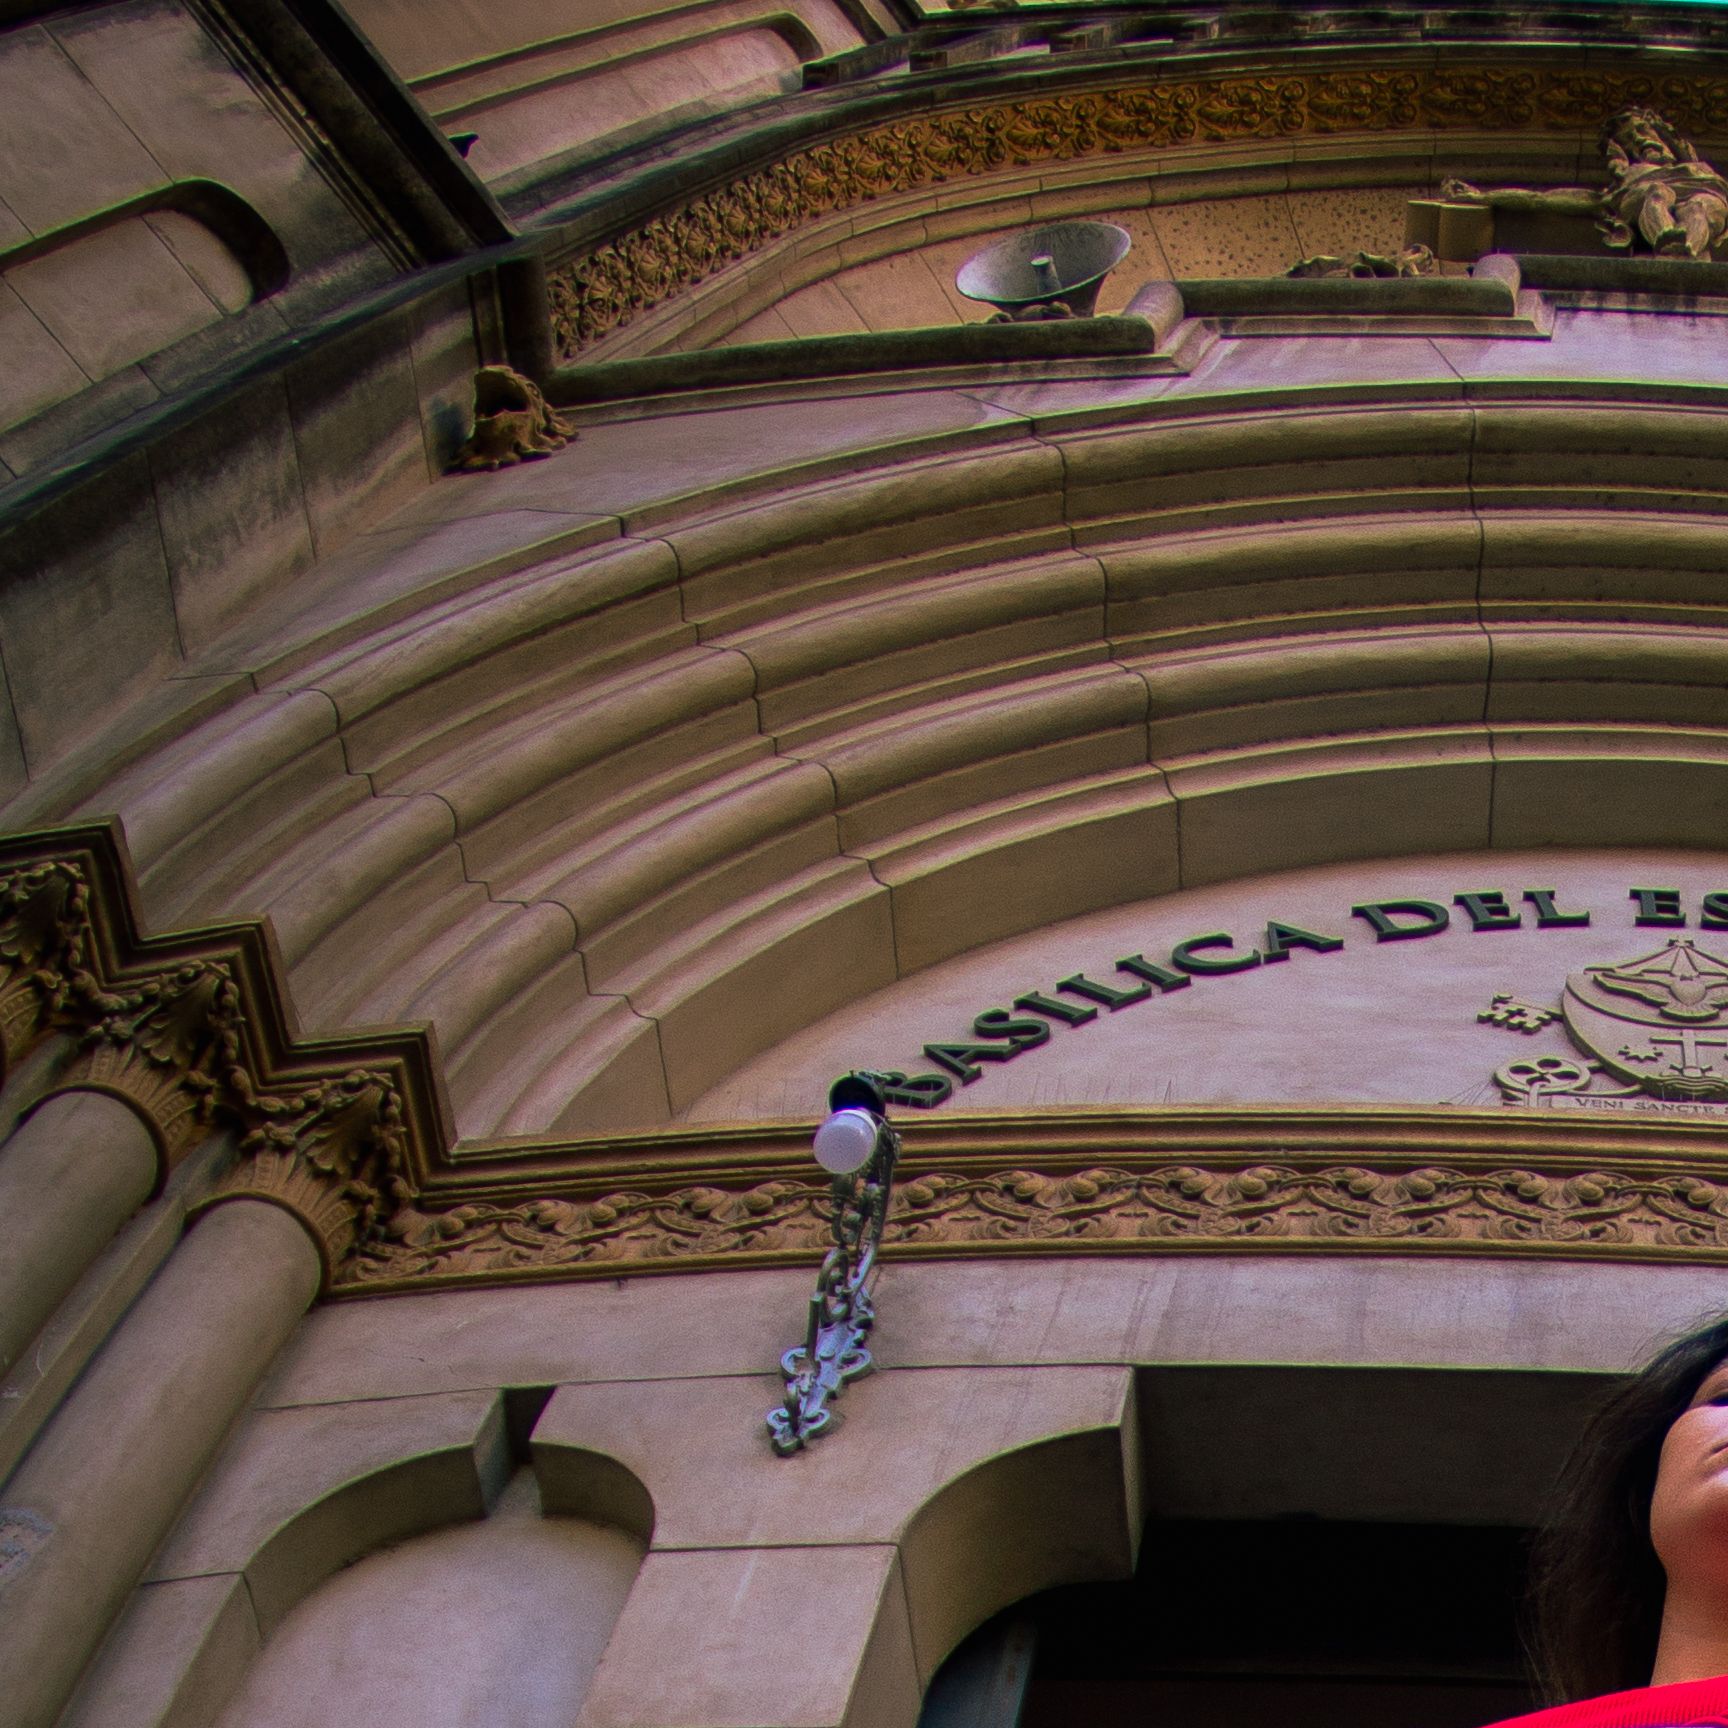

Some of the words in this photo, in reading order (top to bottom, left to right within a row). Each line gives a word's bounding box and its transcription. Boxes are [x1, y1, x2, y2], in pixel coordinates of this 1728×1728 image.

[885, 921, 1343, 1109] BASILICA
[1351, 888, 1590, 942] DEL
[1575, 1098, 1624, 1110] VENI
